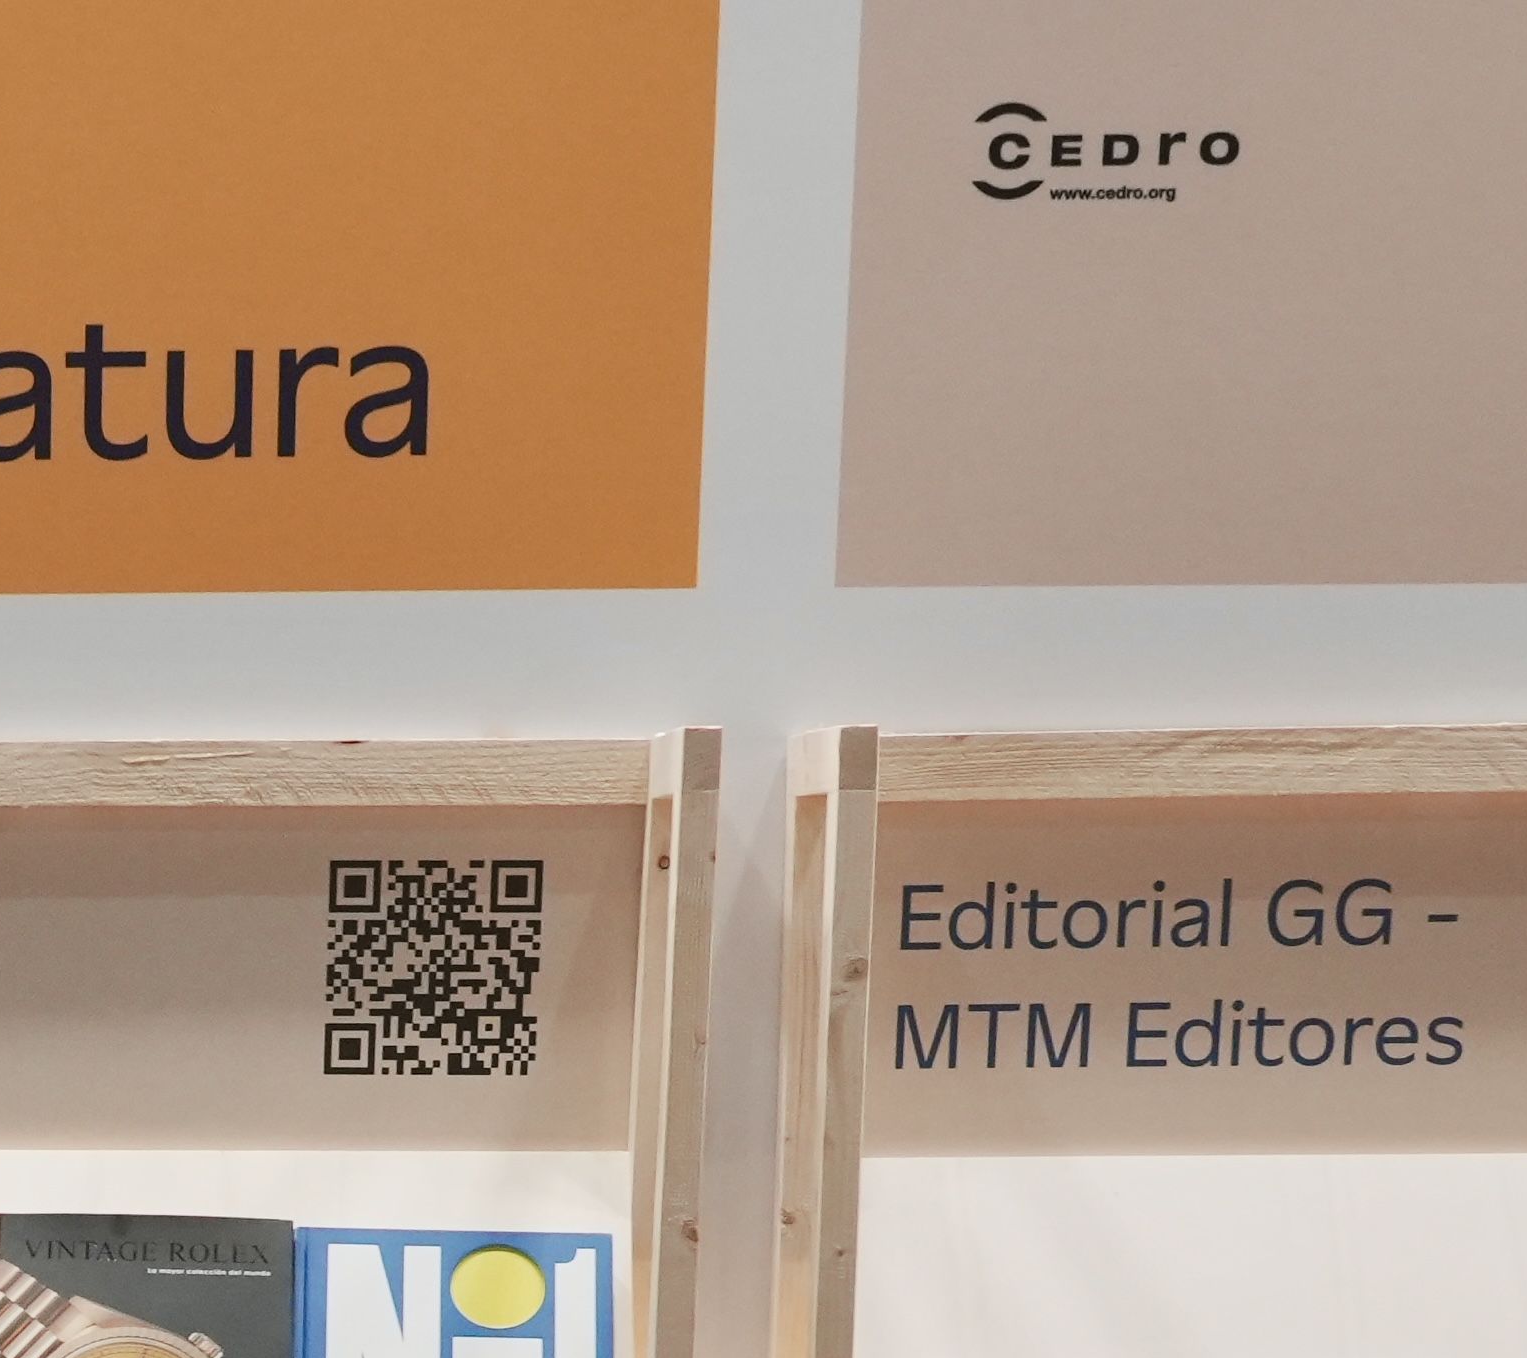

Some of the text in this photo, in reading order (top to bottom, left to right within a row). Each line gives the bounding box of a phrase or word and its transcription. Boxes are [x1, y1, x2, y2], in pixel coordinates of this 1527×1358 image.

[1050, 185, 1176, 202] www.cedro.org
[900, 879, 1232, 950] Editorial
[1267, 878, 1393, 946] GG
[894, 1000, 1464, 1070] MTM Editores
[25, 1238, 271, 1265] VINTAGE ROLEX
